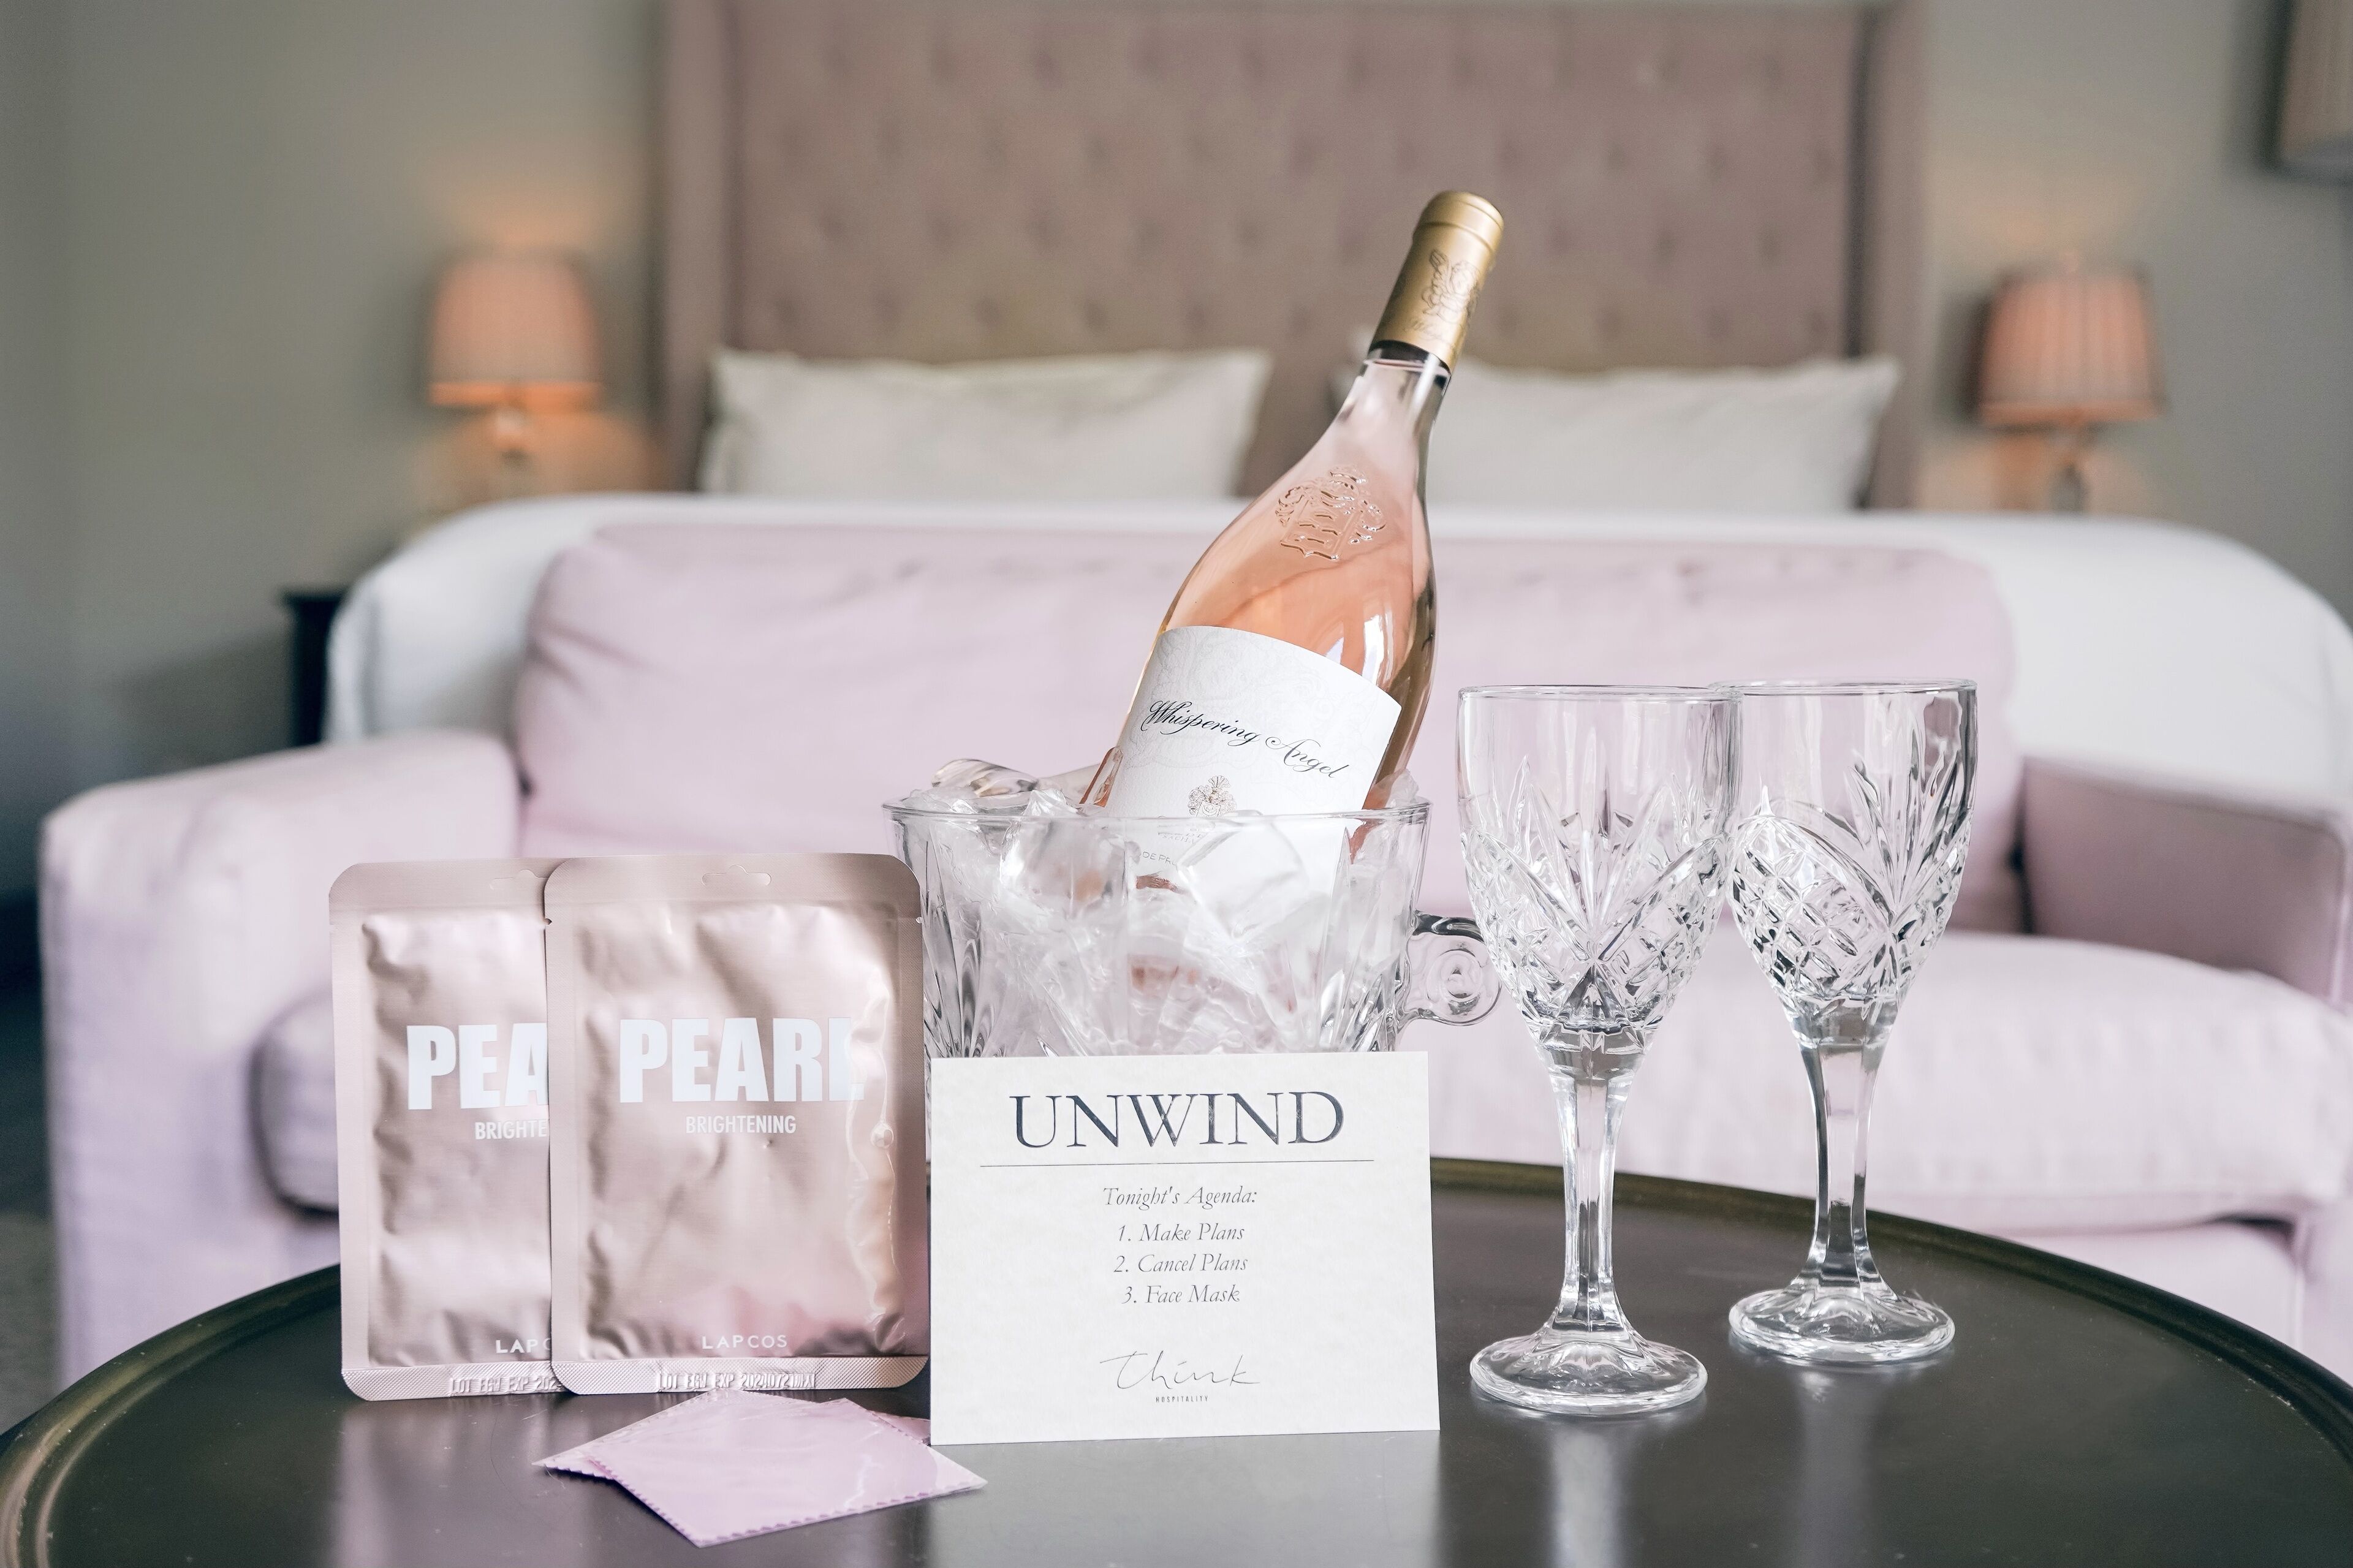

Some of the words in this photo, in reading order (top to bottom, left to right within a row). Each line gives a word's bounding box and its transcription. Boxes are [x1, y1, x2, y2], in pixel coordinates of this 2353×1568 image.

[1140, 700, 1260, 746] Whispering
[1265, 737, 1349, 778] Angel
[406, 1023, 548, 1110] PEA
[620, 1017, 865, 1103] PEARL
[475, 1119, 547, 1140] BRIGHTE
[686, 1115, 797, 1134] BRIGHTENING
[1009, 1091, 1344, 1148] UNWIND
[1103, 1186, 1180, 1211] Tonight's
[1183, 1186, 1257, 1210] Agenda:
[1118, 1224, 1132, 1242] 1.
[1139, 1224, 1191, 1241] Make
[1197, 1223, 1245, 1241] Plans
[1113, 1255, 1129, 1273] 2.
[1138, 1254, 1197, 1273] Cancel
[1200, 1253, 1248, 1272] Plans
[1121, 1286, 1137, 1305] 3.
[1145, 1285, 1183, 1303] Face
[1188, 1284, 1240, 1303] Mask
[495, 1337, 551, 1354] LAPC
[702, 1335, 788, 1349] LAPCOS
[714, 1372, 735, 1389] EXP
